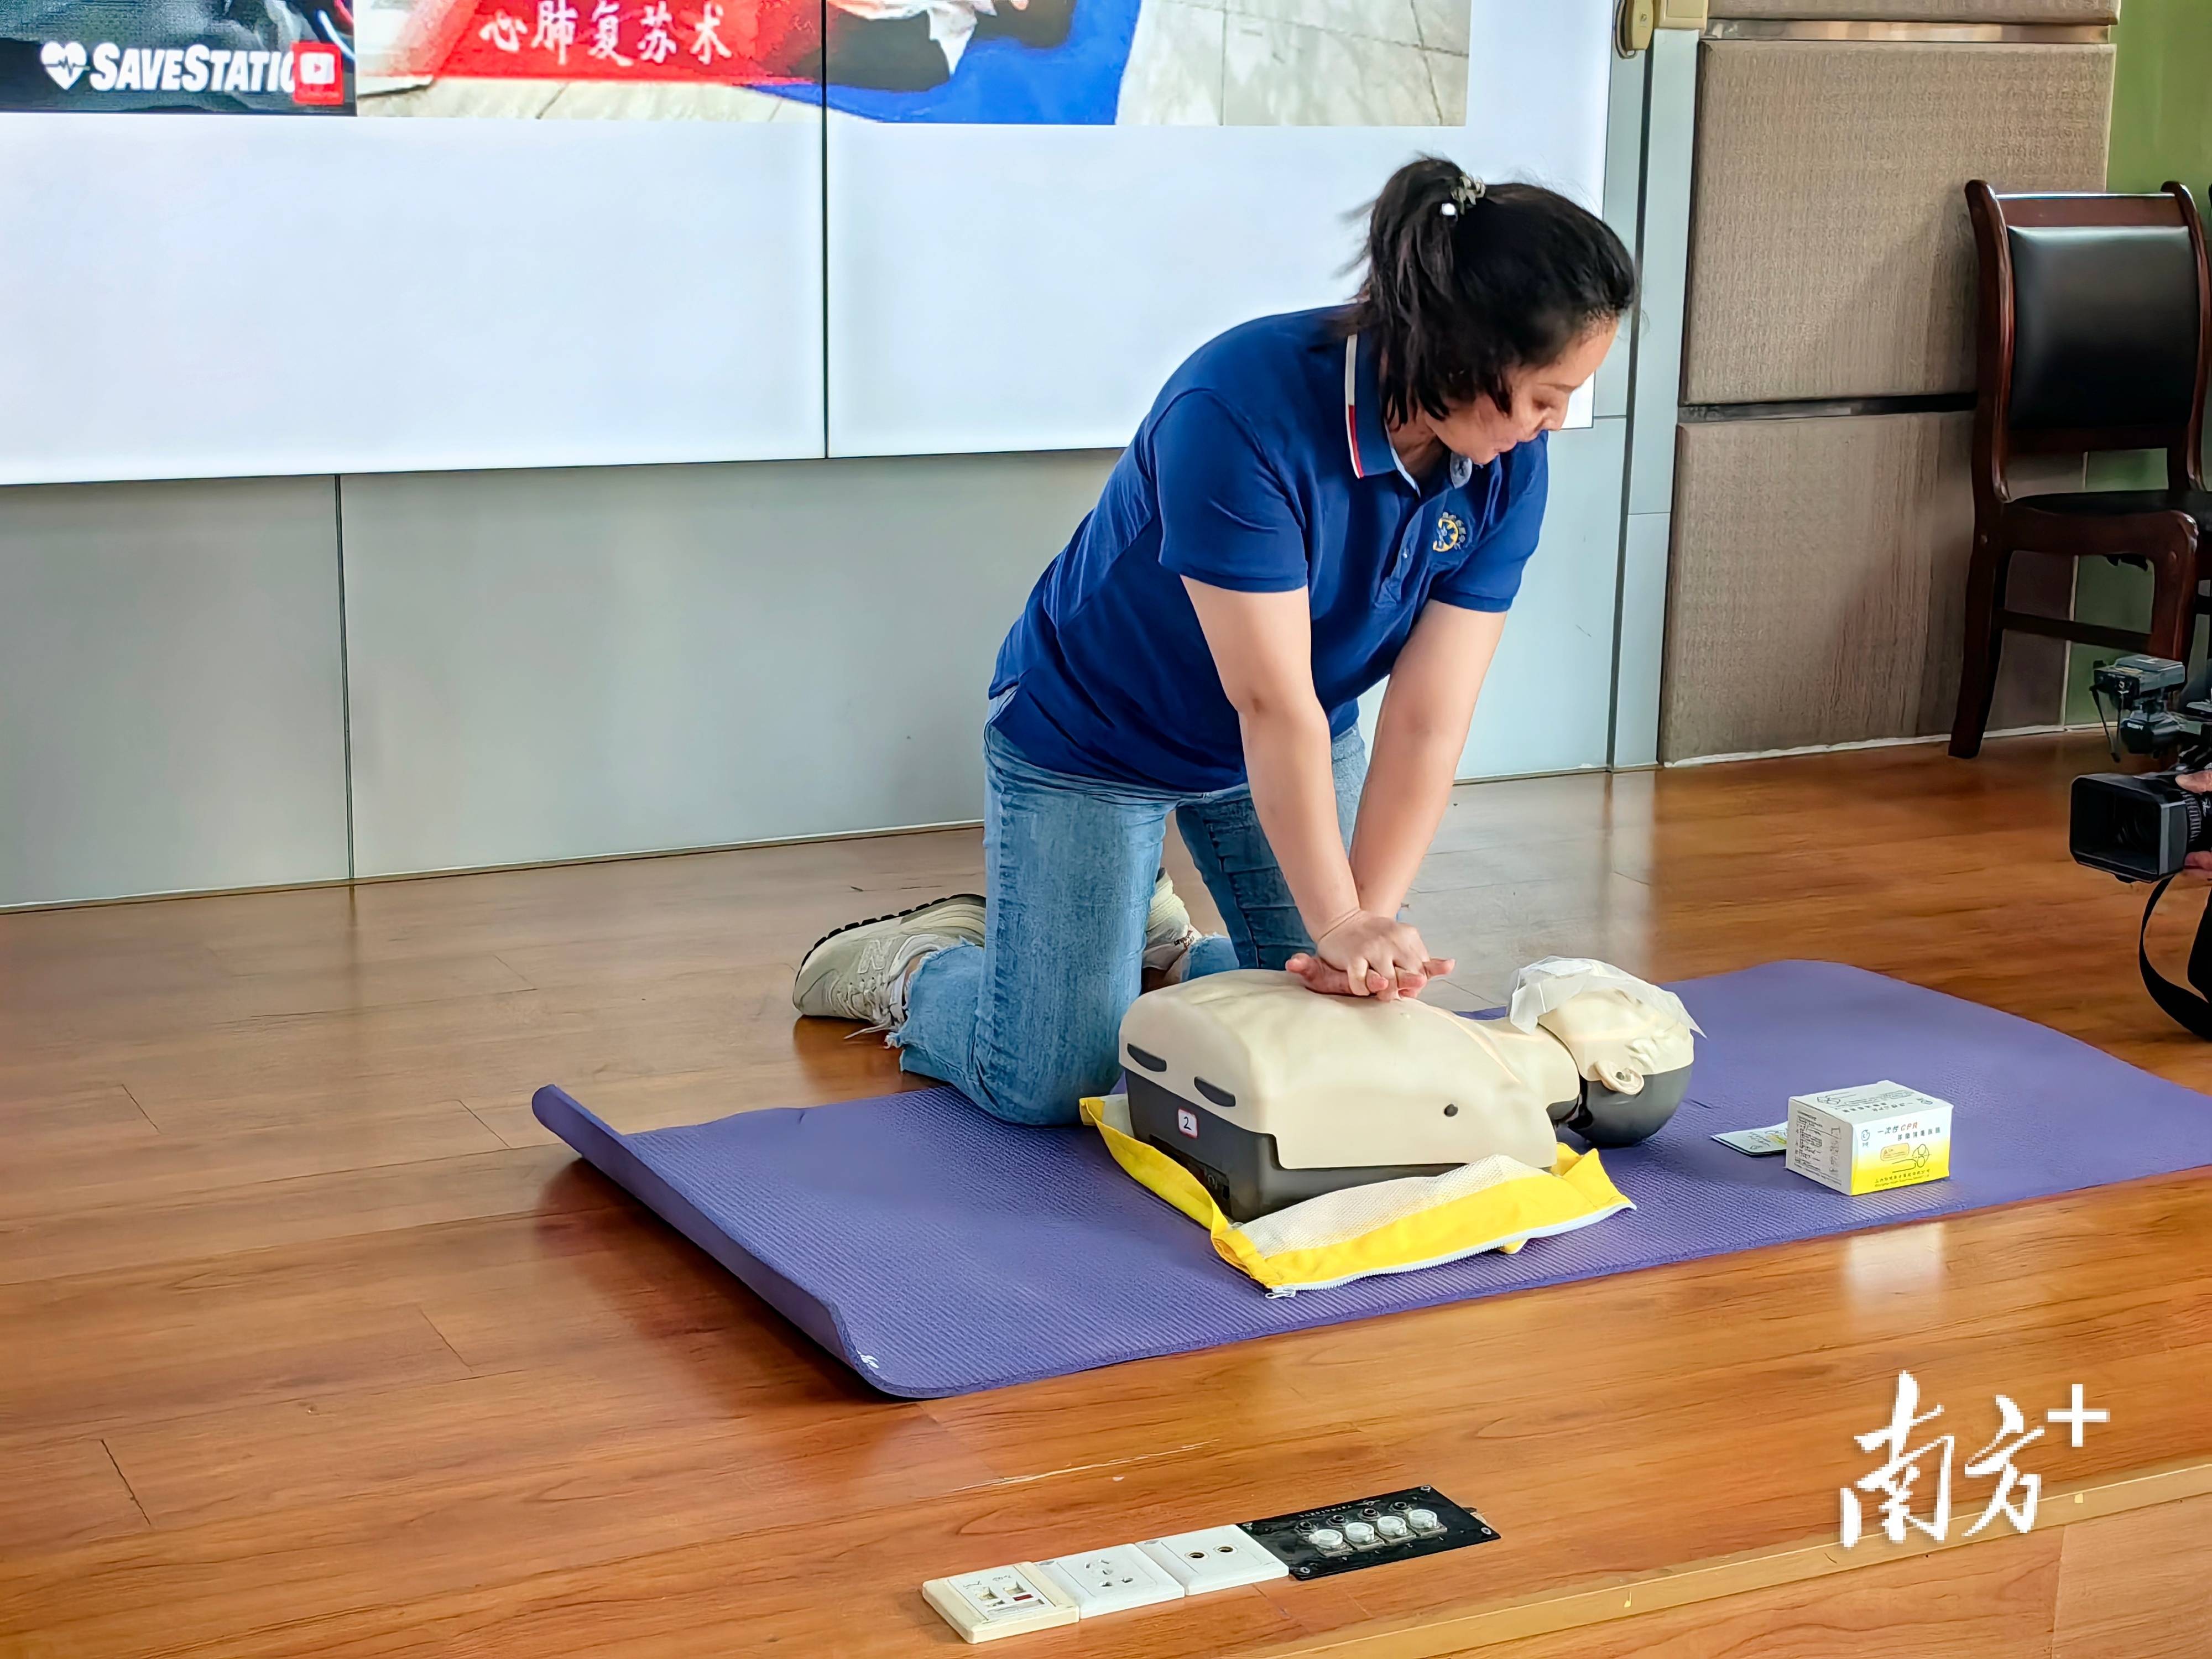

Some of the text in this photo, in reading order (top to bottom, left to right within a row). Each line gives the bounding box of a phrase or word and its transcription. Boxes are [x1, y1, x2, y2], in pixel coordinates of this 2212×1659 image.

[478, 0, 732, 65] 心肺复苏术
[1183, 1116, 1192, 1131] 2
